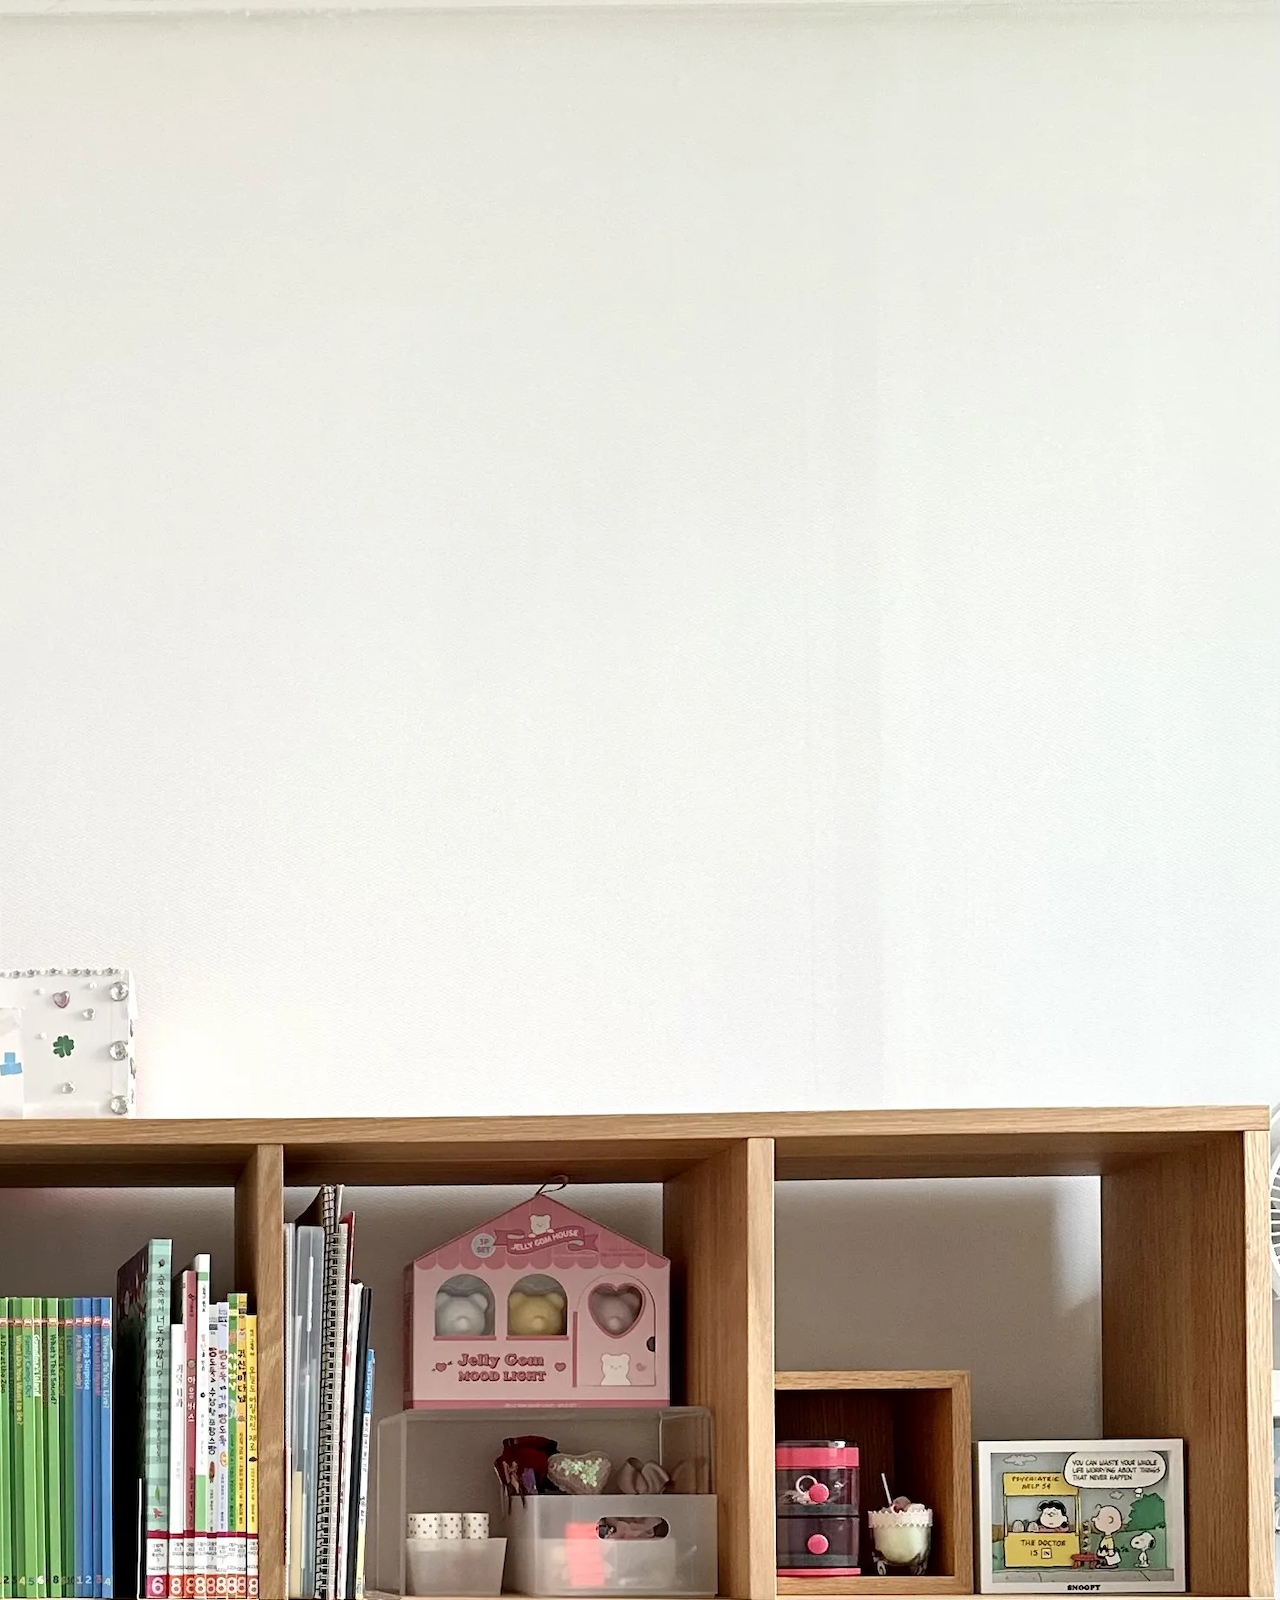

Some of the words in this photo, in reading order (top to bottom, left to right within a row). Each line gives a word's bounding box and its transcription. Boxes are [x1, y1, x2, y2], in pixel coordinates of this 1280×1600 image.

[511, 1239, 534, 1251] JELLY
[534, 1236, 552, 1247] GOM
[552, 1229, 580, 1242] HOUSE
[476, 1246, 491, 1254] SET
[83, 1333, 91, 1357] Spring
[0, 1356, 7, 1364] at
[457, 1353, 500, 1369] Jelly
[504, 1353, 544, 1367] Gom
[83, 1359, 91, 1389] Surprise
[458, 1371, 501, 1382] MOOD
[503, 1371, 546, 1382] LIGHT
[3, 1575, 9, 1583] 2
[37, 1576, 44, 1584] 6
[53, 1575, 59, 1583] 8
[77, 1576, 83, 1584] 1
[85, 1575, 92, 1584] 2
[151, 1577, 164, 1594] 6
[171, 1577, 181, 1594] 8
[195, 1577, 206, 1594] 8
[206, 1577, 216, 1594] 8
[216, 1576, 226, 1594] 8
[248, 1577, 258, 1595] 8
